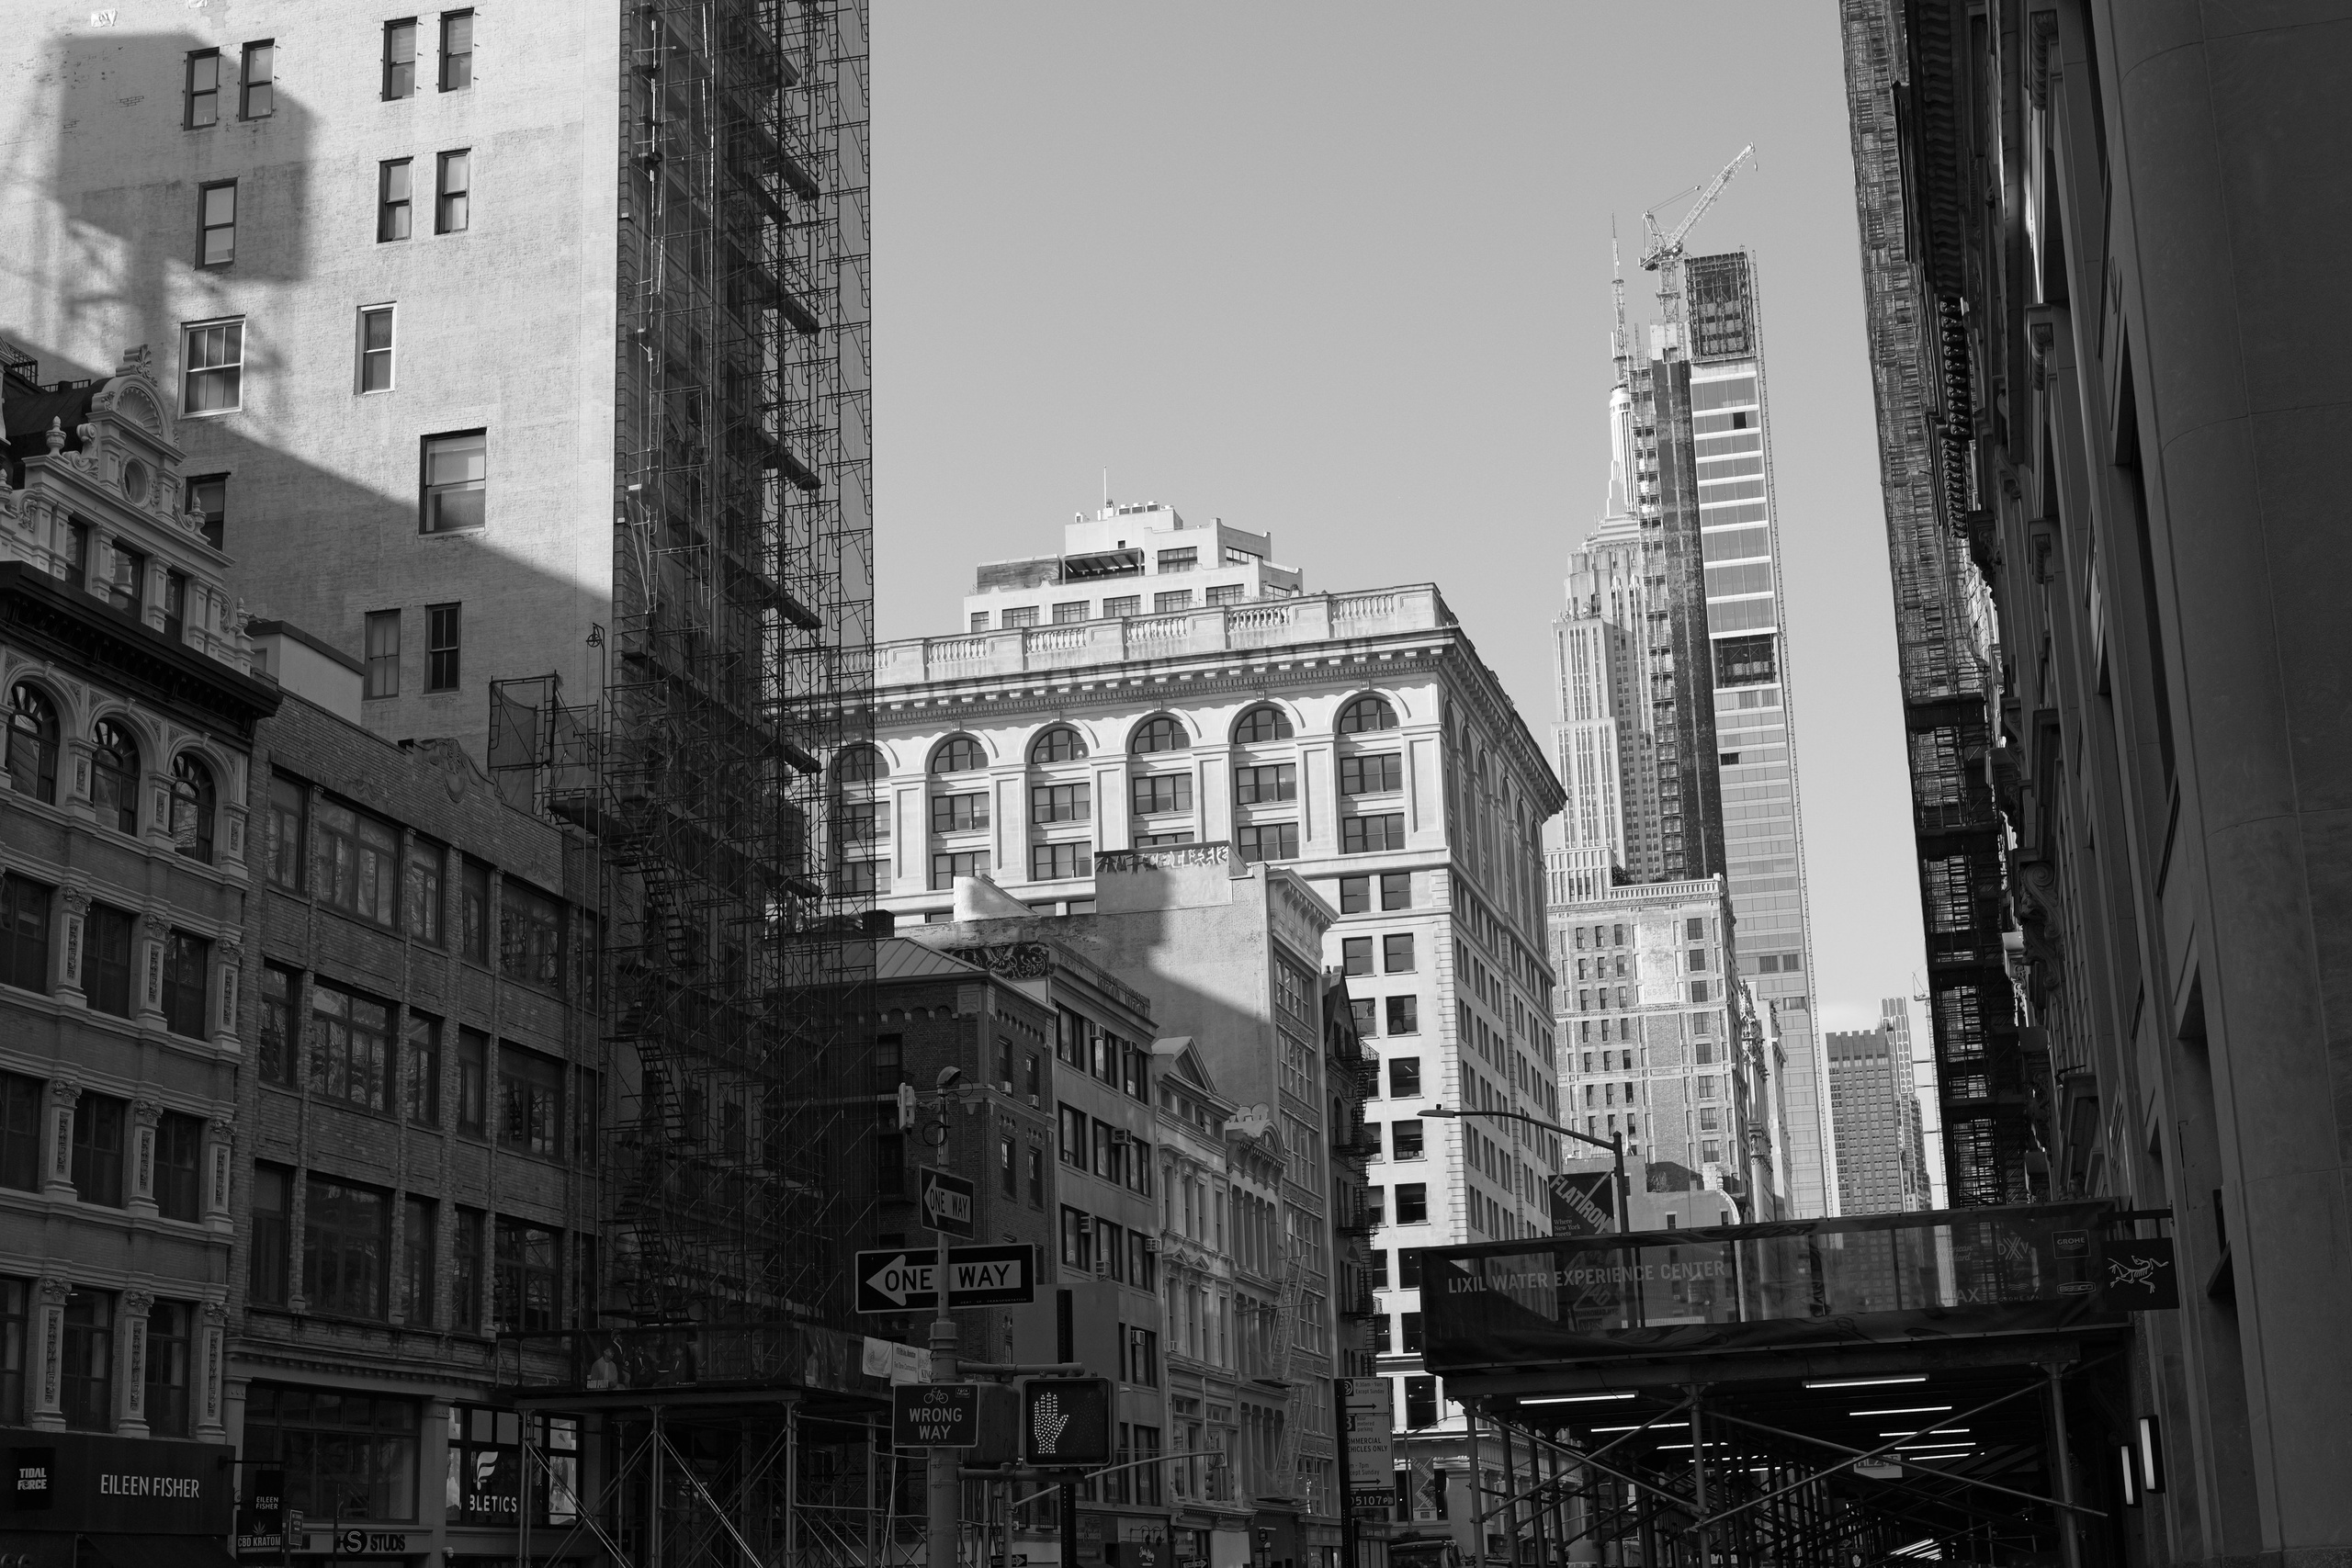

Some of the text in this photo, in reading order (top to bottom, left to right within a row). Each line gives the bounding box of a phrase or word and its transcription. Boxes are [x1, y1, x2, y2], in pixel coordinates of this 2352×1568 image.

[930, 1188, 968, 1220] ONE WAY
[1550, 1174, 1614, 1234] FLATIRON
[2057, 1236, 2086, 1246] GROHE
[885, 1264, 1011, 1292] ONE WAY
[1448, 1259, 1725, 1294] LIXIL WATER EXPERIENCE CENTER
[1935, 1288, 1981, 1305] IAX
[910, 1407, 963, 1423] WRONG
[919, 1425, 952, 1440] WAY
[1348, 1445, 1372, 1453] EHICLES
[18, 1467, 47, 1479] TIDAL
[17, 1479, 47, 1491] FORCE
[100, 1473, 200, 1499] EILEEN FISHER
[469, 1495, 517, 1513] BLETICS
[238, 1536, 281, 1548] CBD KRATOM
[370, 1533, 406, 1551] STUDS
